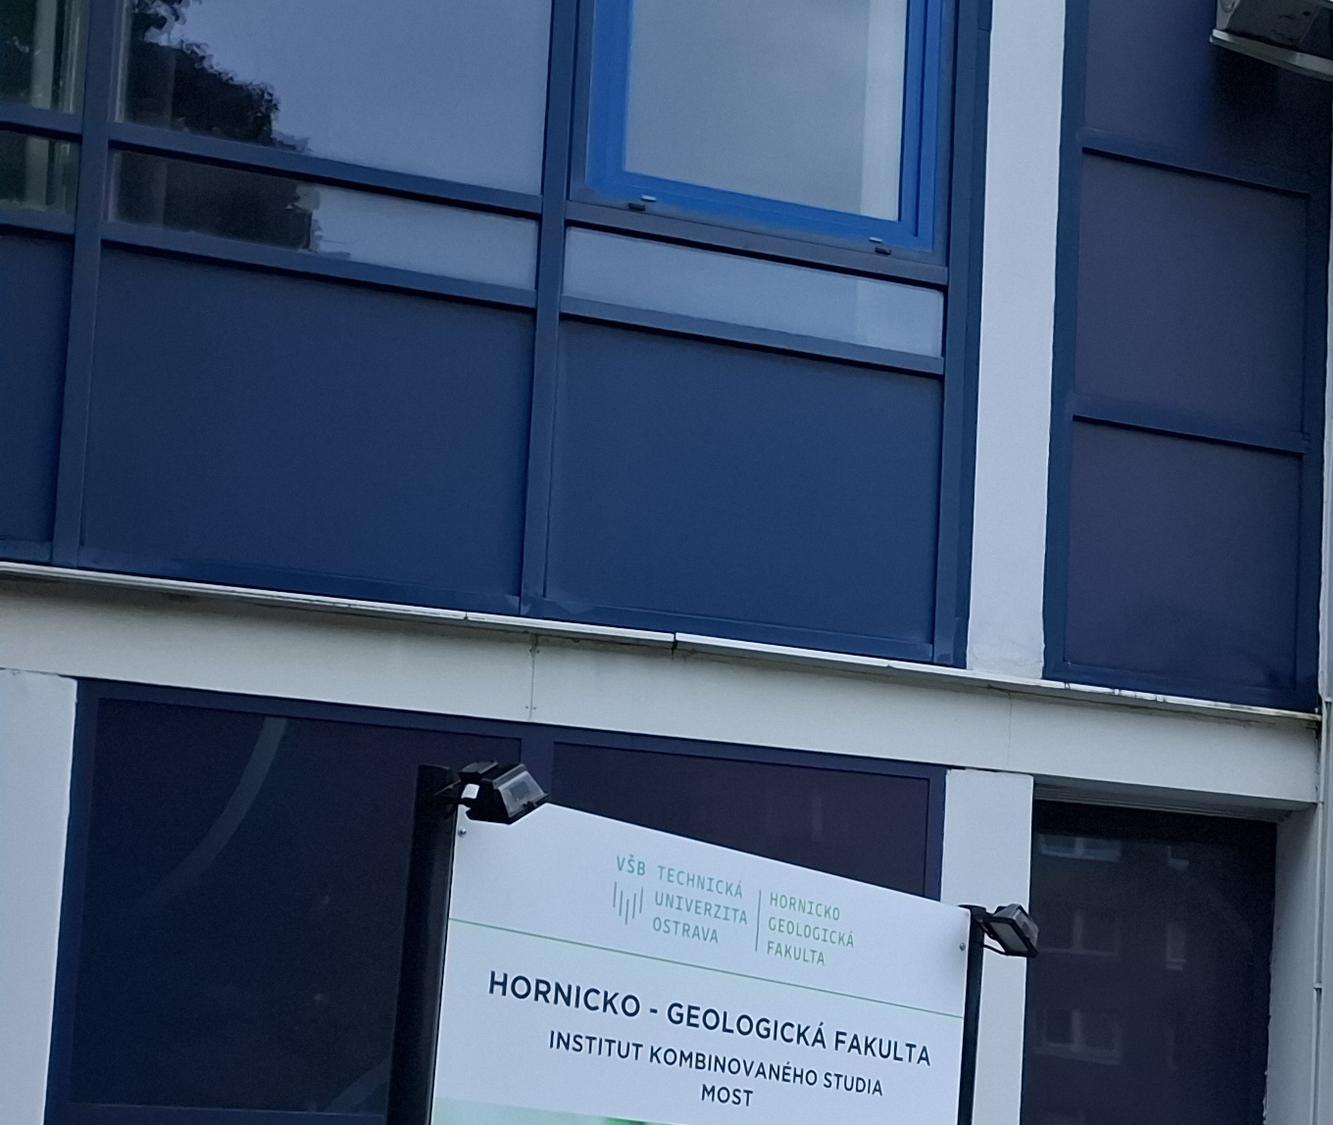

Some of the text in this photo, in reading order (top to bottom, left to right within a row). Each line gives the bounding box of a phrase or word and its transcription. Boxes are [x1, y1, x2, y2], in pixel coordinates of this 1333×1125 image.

[616, 854, 743, 898] VŠB TECHNICKÁ
[654, 891, 748, 925] UNIVERZITA
[769, 892, 841, 921] HORNICKO
[653, 916, 719, 944] OSTRAVA
[768, 916, 855, 948] GEOLOGICKÁ
[766, 940, 826, 966] FAKULTA
[488, 970, 640, 1018] HORNICKO
[667, 1002, 826, 1049] GEOLOGICKÁ
[835, 1031, 931, 1066] FAKULTA
[549, 1030, 883, 1096] INSTITUT KOMBINOVANÉHO STUDIA
[701, 1084, 753, 1107] MOST
